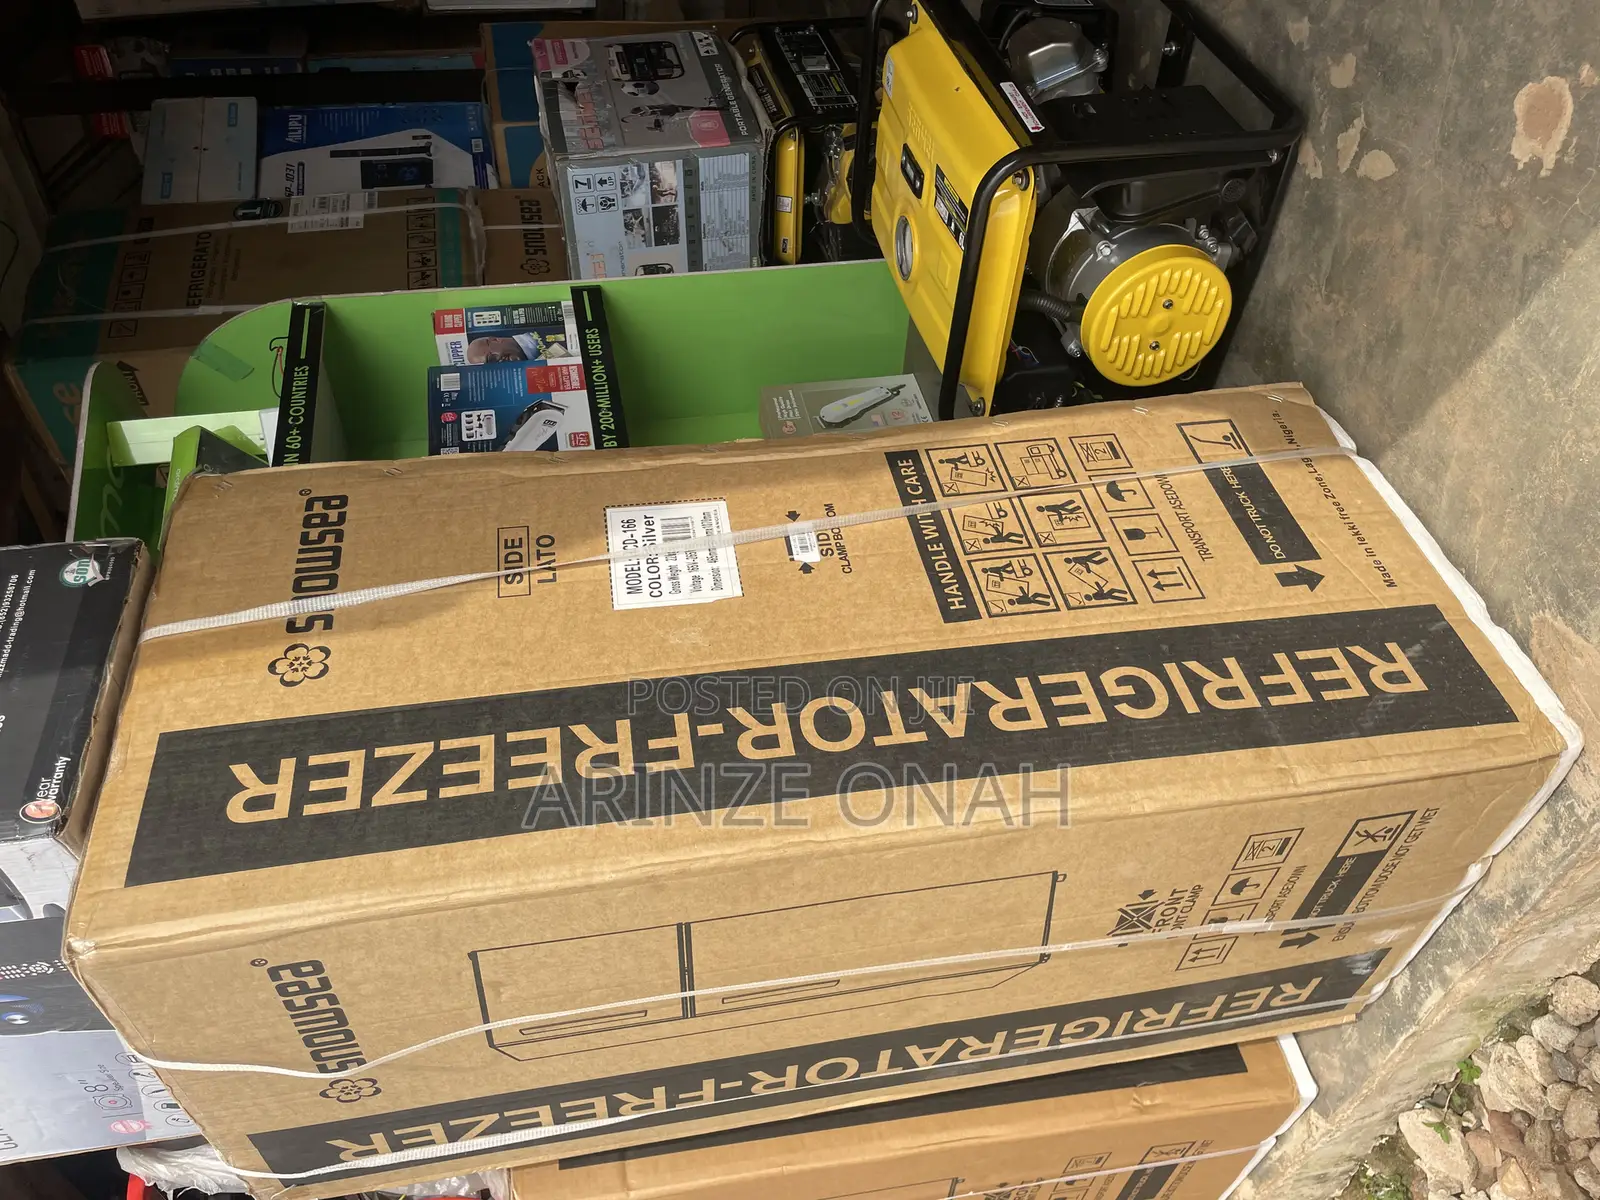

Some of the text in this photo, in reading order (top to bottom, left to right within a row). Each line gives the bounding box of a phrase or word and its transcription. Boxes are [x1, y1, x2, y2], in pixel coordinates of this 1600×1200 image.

[713, 63, 749, 136] PORTABLE GENERATOR
[607, 176, 615, 186] UP
[186, 229, 213, 308] EFRIGERATO
[289, 364, 310, 425] COUNTRIES
[585, 327, 618, 448] BY 200 MILLION+ USERS
[286, 425, 303, 450] 60+
[897, 458, 968, 611] HANDLE WITH CARE
[1175, 511, 1215, 562] TRANSPORT
[1220, 466, 1287, 559] DO NOT TRUCK HERE
[1332, 501, 1351, 521] free
[1348, 522, 1367, 545] lekki
[285, 494, 350, 635] sowsea
[503, 536, 524, 586] SIDE
[535, 533, 558, 585] LATO
[621, 518, 643, 595] MODEL: CD-166
[816, 528, 835, 558] SID
[823, 503, 853, 575] CLAMP BOOM
[1366, 548, 1377, 558] in
[646, 553, 663, 598] COLOR:
[1373, 560, 1398, 589] Made
[226, 641, 1429, 826] REFRIGERATOR-FREEZER
[47, 755, 72, 804] warranty
[1180, 884, 1205, 914] CLAMP
[1278, 864, 1308, 899] ASEDOWN
[1318, 878, 1343, 904] TRUCK
[1337, 856, 1358, 878] HERE
[1331, 807, 1441, 942] ENSU BOTTOM DOSE NOT GET WET
[267, 960, 368, 1074] snowsea
[325, 976, 1323, 1162] REFRIGERATOR-FREEZER
